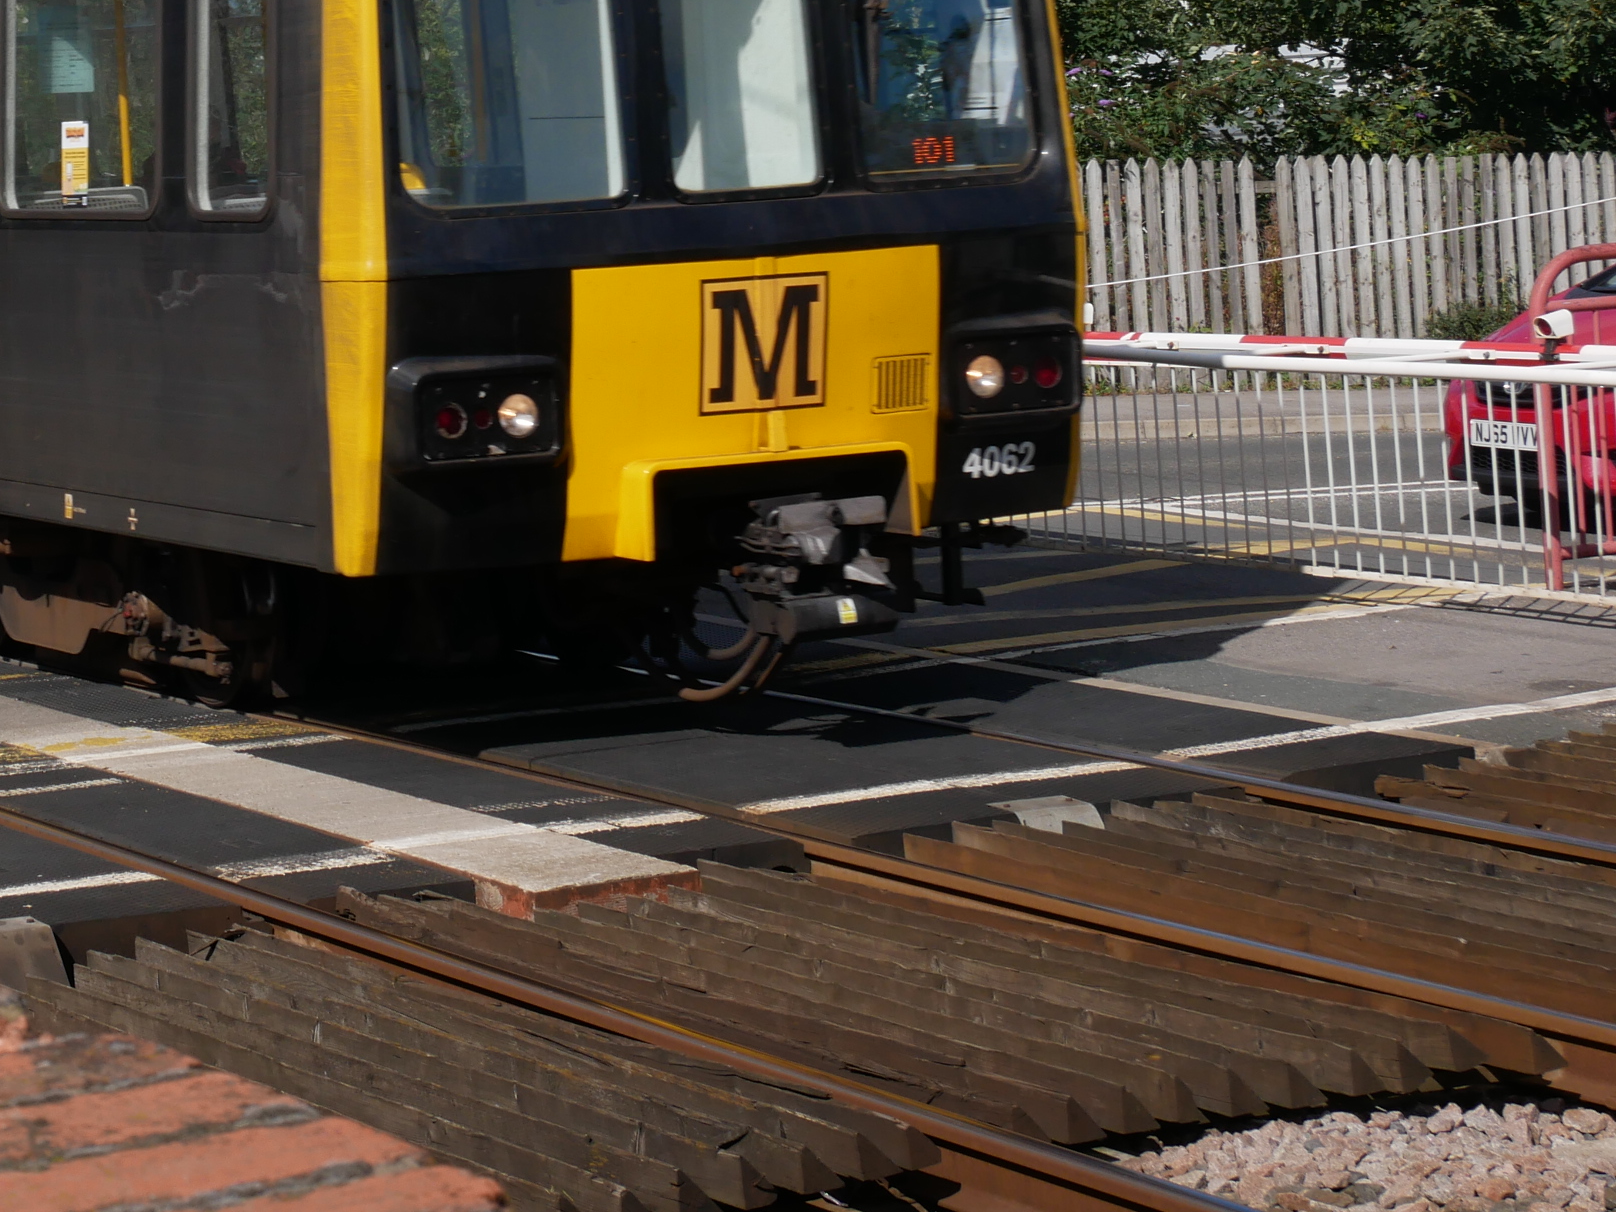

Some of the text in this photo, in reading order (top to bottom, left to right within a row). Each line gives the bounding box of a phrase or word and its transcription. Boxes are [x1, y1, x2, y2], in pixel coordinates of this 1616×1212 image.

[912, 136, 955, 164] 101
[709, 284, 820, 404] M
[962, 441, 1036, 478] 4062
